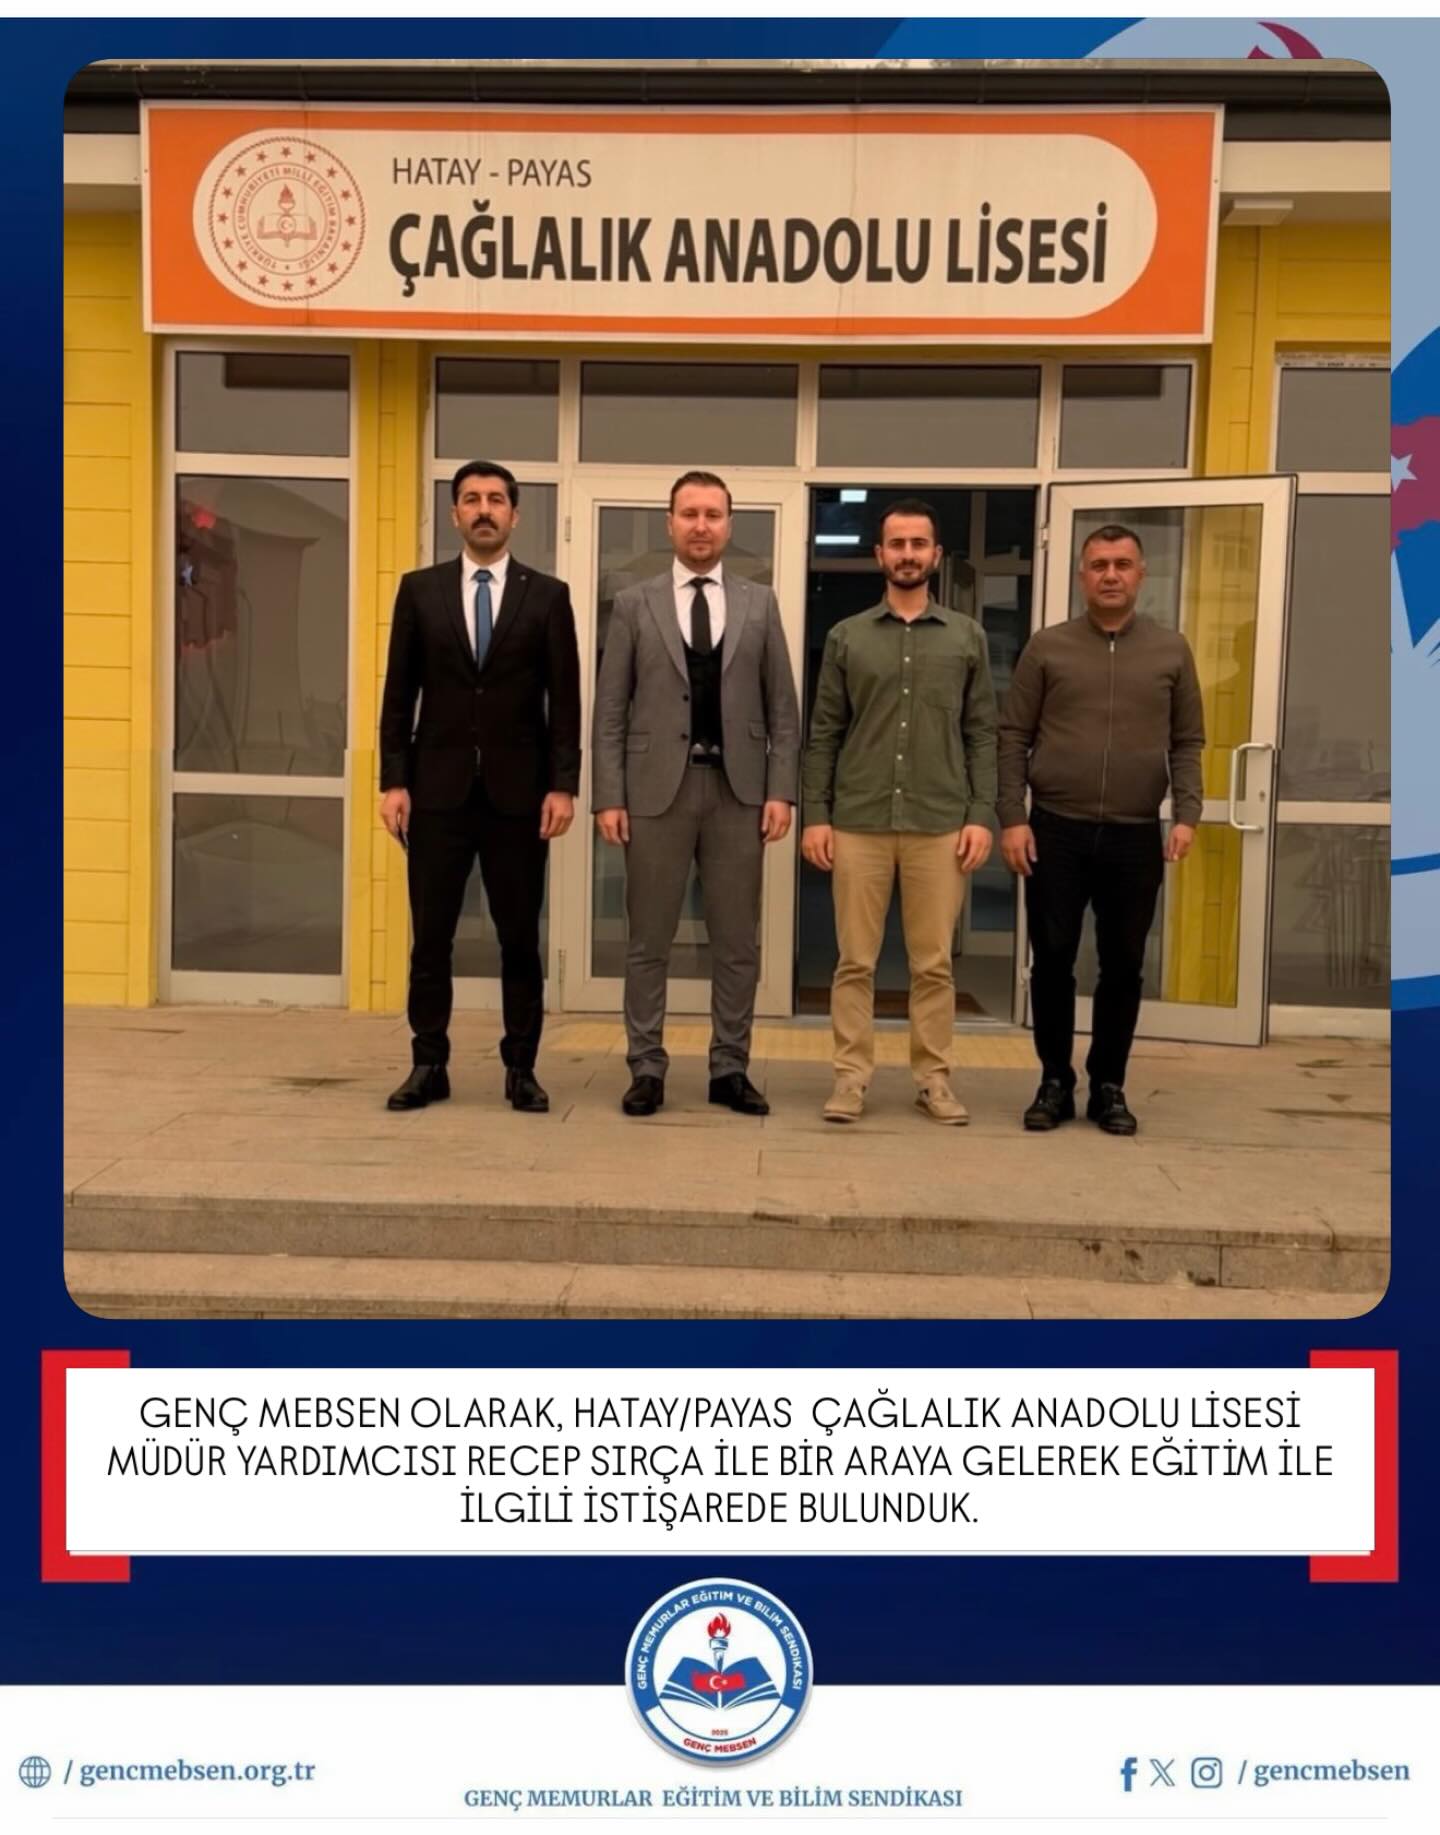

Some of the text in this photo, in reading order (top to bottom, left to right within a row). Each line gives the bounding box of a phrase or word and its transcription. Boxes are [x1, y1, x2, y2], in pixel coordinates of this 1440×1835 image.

[392, 157, 482, 185] HATAY
[507, 158, 592, 188] PAYAS
[389, 199, 1107, 298] ÇAĞLALIK ANADOLU LİSESİ
